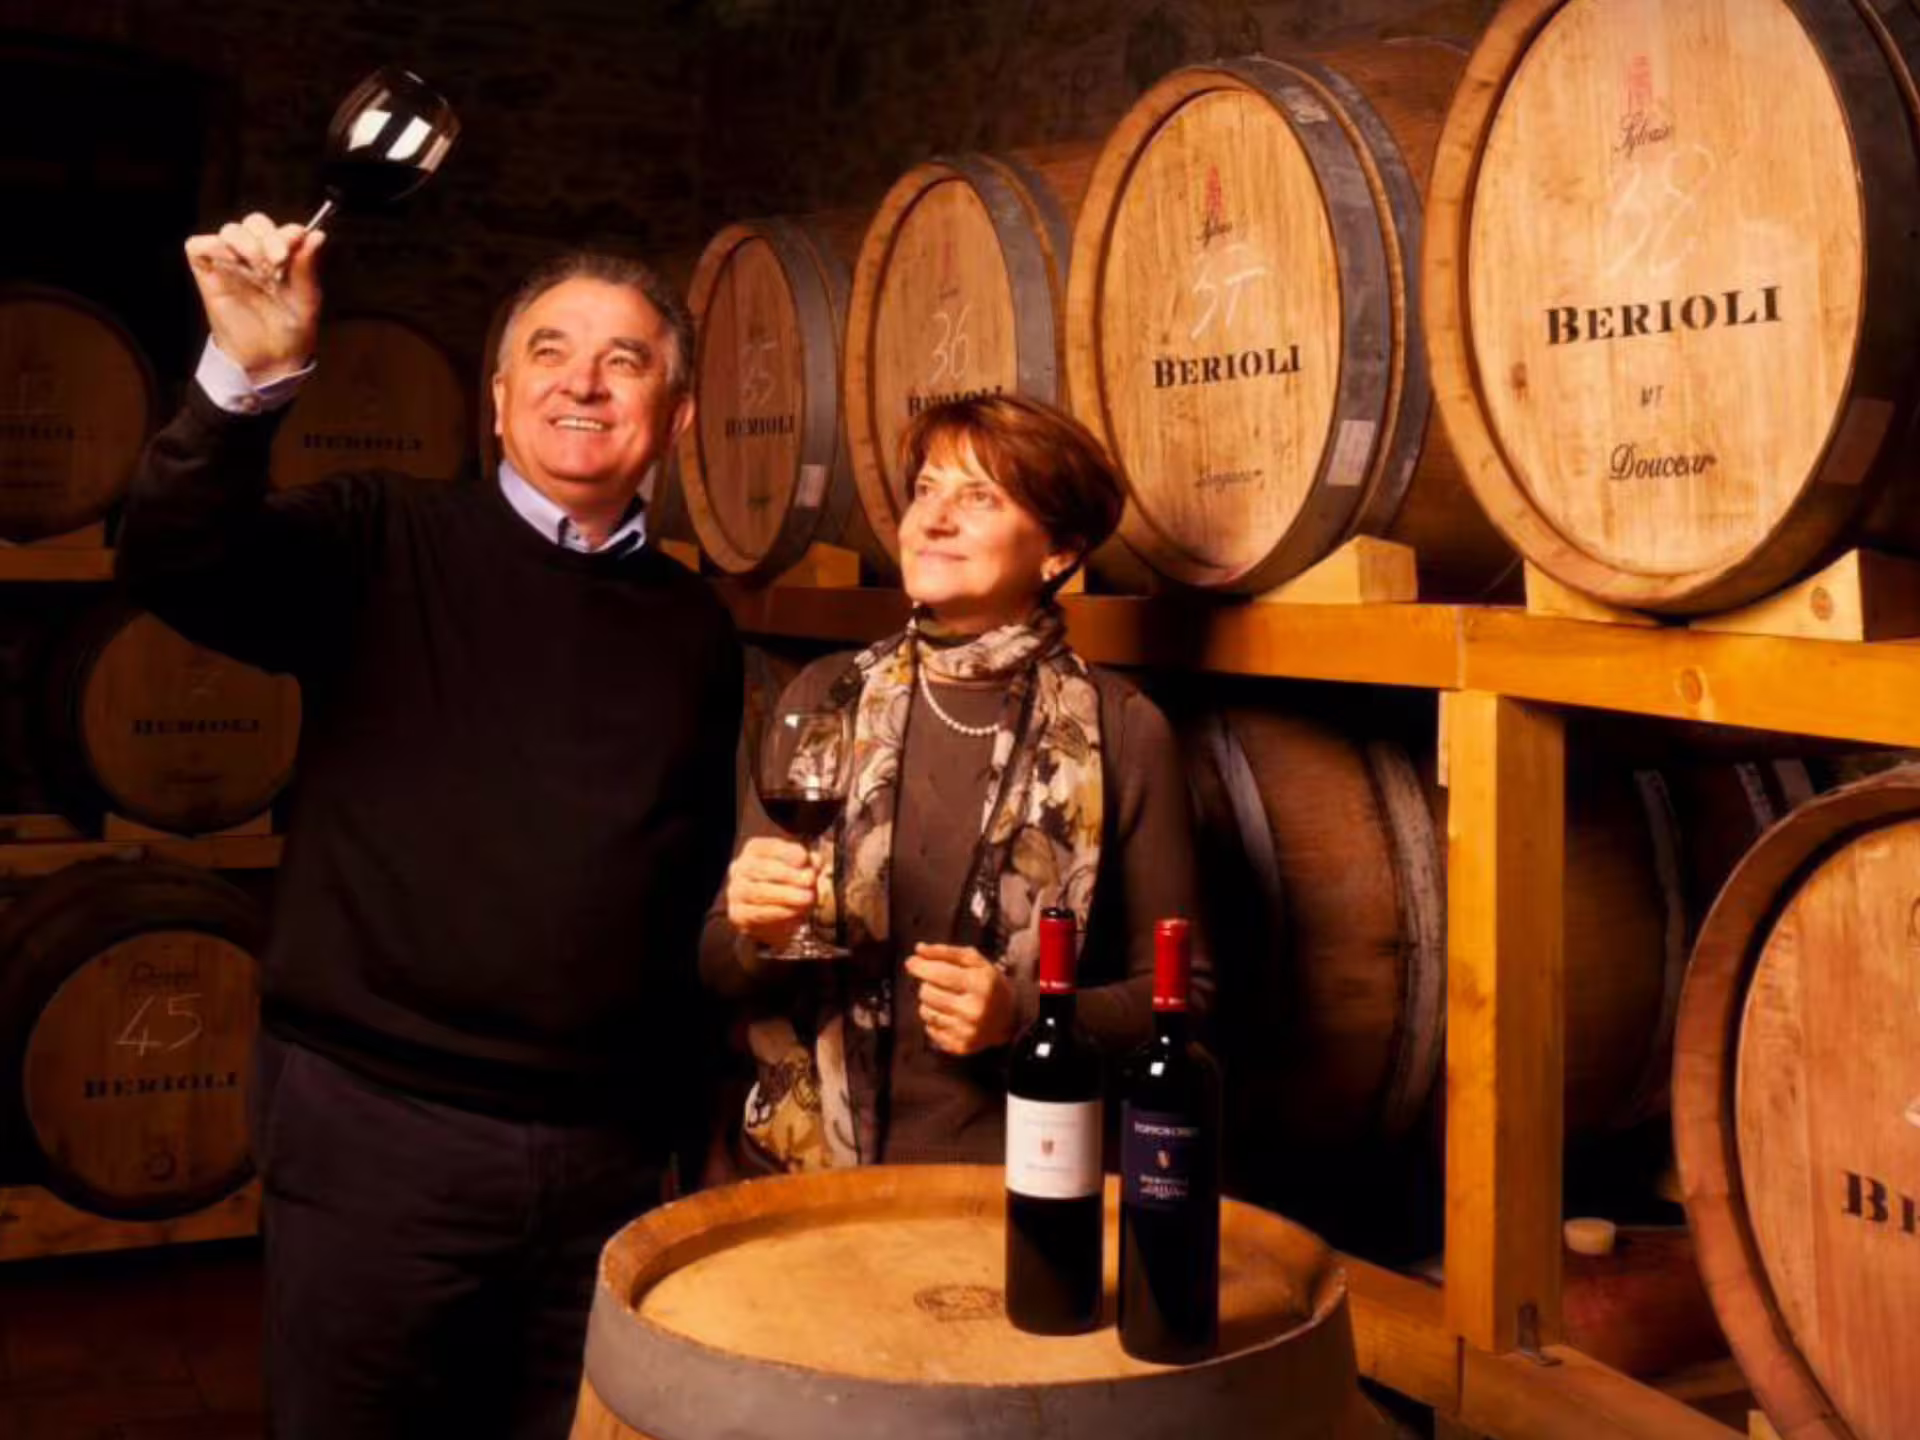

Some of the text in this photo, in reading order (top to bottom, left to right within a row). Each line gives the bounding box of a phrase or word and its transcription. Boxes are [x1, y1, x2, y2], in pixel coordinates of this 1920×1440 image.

[929, 304, 972, 384] 36
[1545, 286, 1782, 345] BERIOLI
[1152, 345, 1301, 388] BERIOLI
[114, 993, 204, 1056] 45
